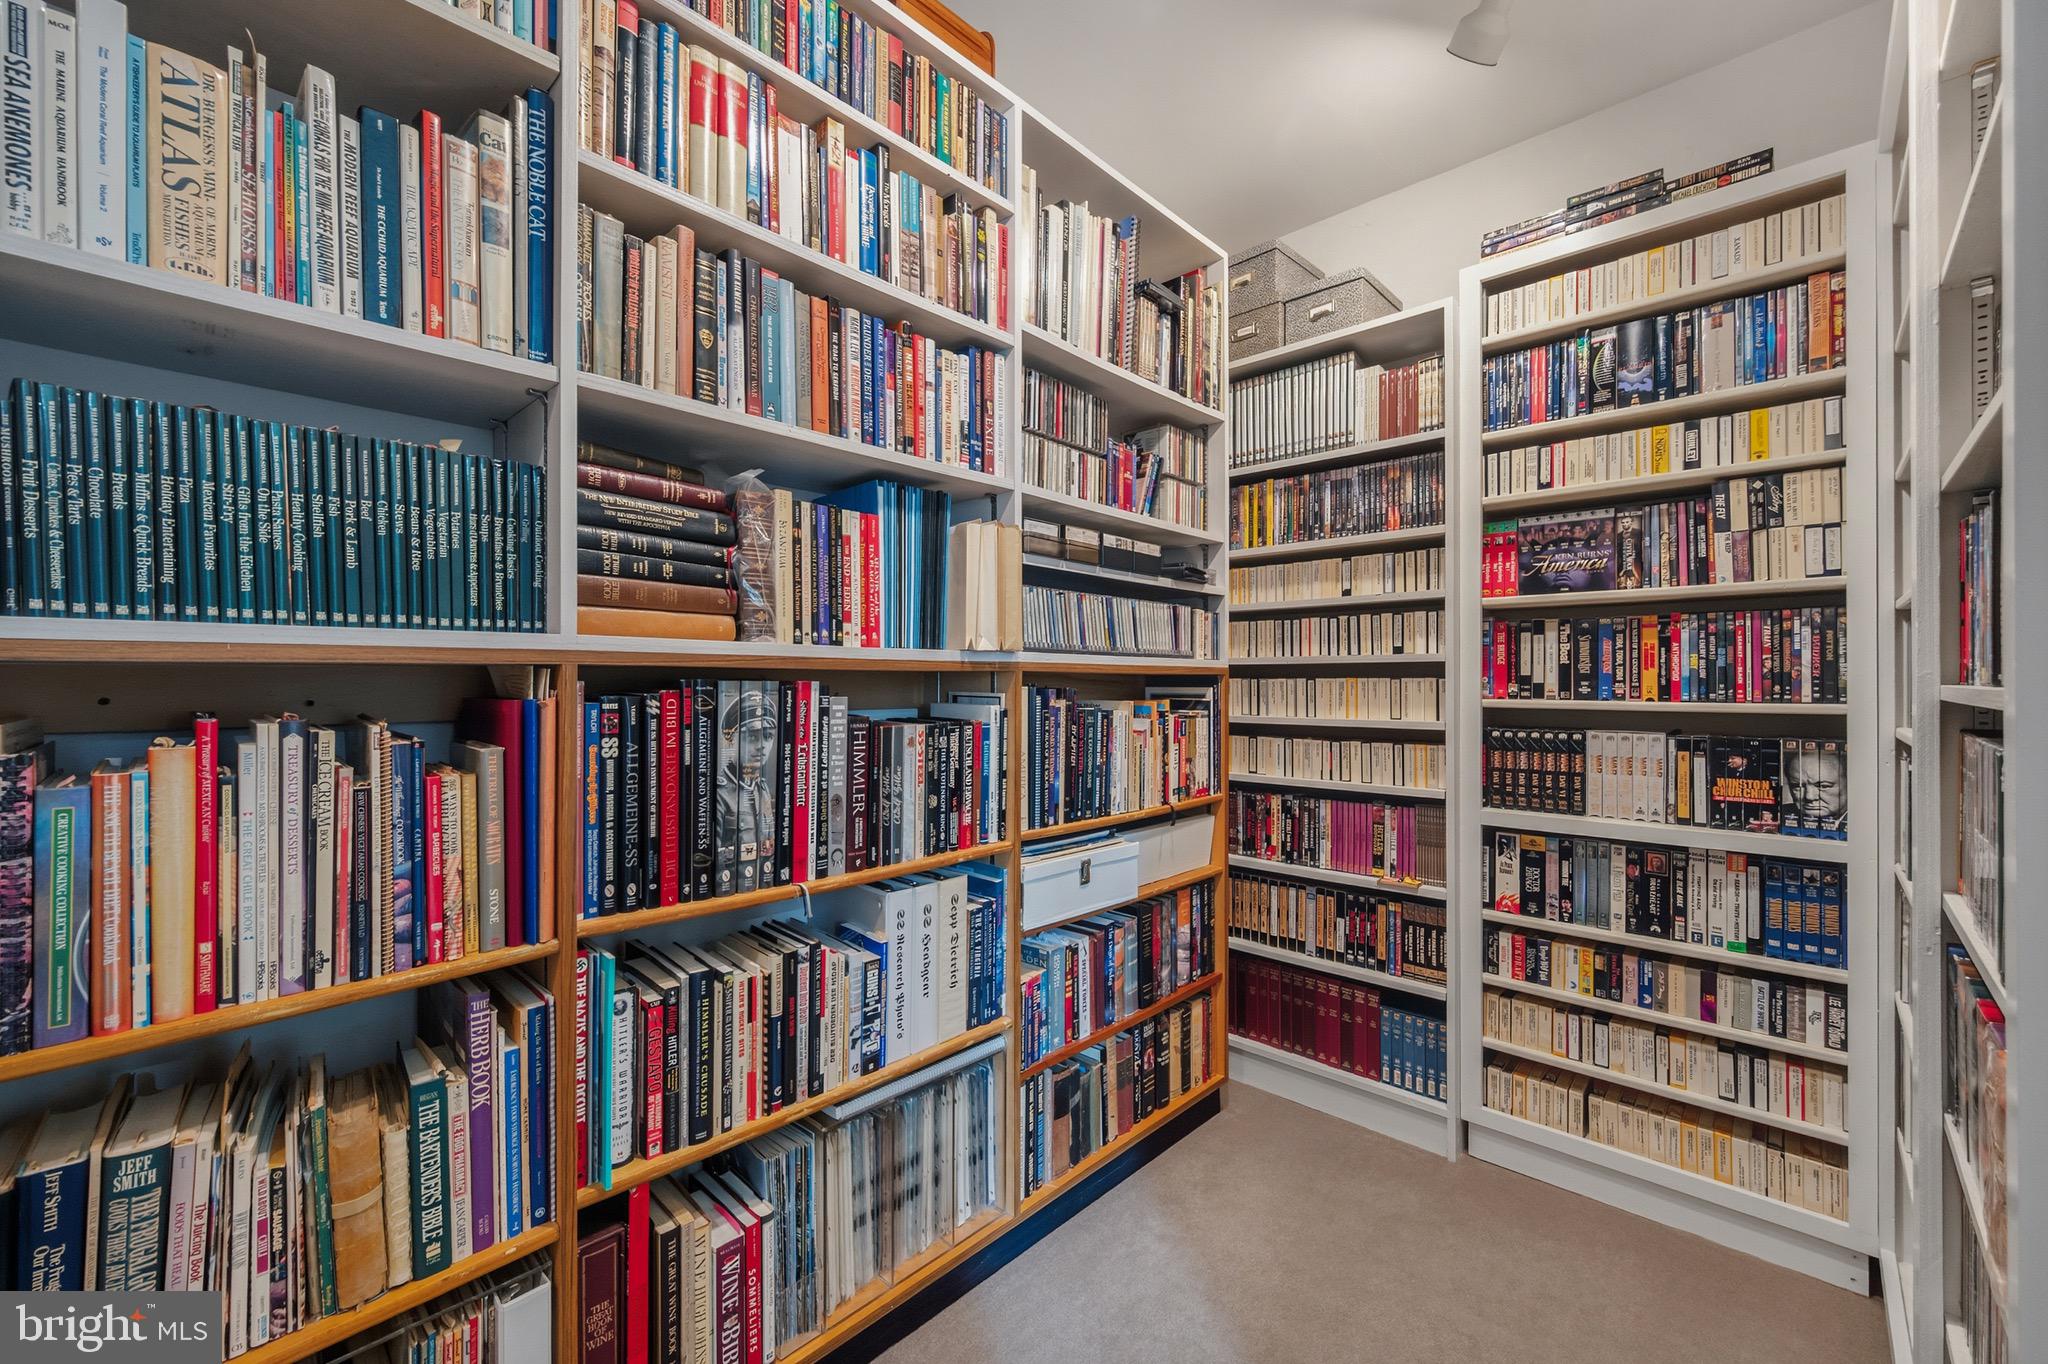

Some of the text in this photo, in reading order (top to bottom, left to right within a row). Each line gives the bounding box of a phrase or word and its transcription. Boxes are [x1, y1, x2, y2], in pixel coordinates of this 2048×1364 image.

[4, 55, 30, 88] SEA
[202, 73, 214, 92] DR.
[4, 89, 31, 191] ANEMONES
[56, 50, 66, 206] THE MARINE AQUARIUM HANDBOOK
[161, 58, 201, 198] ATLAS
[203, 99, 215, 165] BURGESS'S
[344, 142, 357, 190] MODERN
[528, 109, 546, 241] THE NOBLE CAT
[163, 194, 171, 246] MINI-EDITION
[175, 198, 189, 250] FISHES
[194, 203, 204, 256] AQUARIUM
[241, 169, 256, 255] SEAHORSES
[345, 194, 358, 217] REEF
[206, 206, 216, 258] OF MARINE
[346, 220, 358, 279] AQUARIUM
[378, 221, 386, 252] CICHLID
[378, 253, 387, 297] AQUARIUM
[629, 249, 640, 277] WORLDS
[628, 289, 640, 328] COLLISION
[864, 369, 872, 401] DECEIT
[22, 459, 40, 538] Fruit Desserts
[66, 464, 82, 486] Pies
[87, 467, 104, 518] Chocolate
[112, 473, 127, 510] Breads
[179, 477, 193, 503] Pizza
[67, 498, 84, 525] Tarts
[159, 475, 175, 583] Holiday Entertaining
[345, 500, 357, 524] Pork
[377, 500, 388, 535] Chicken
[346, 540, 358, 568] Lamb
[843, 556, 851, 576] END
[699, 716, 707, 774] ALLGEMEINE
[287, 745, 298, 805] TREASURY
[318, 740, 332, 851] THE ICE CREAM BOOK
[852, 730, 866, 815] HIMMLER
[242, 820, 253, 838] THE
[625, 742, 639, 867] ALLGEMEINE-SS
[698, 797, 707, 849] WAFFEN-SS
[242, 841, 253, 873] GREAT
[288, 819, 299, 875] DESSERTS
[54, 813, 68, 950] CREATIVE COOKING COLLECTION
[242, 876, 253, 903] CHILE
[489, 889, 499, 924] STONE
[242, 906, 253, 933] BOOK
[471, 1009, 492, 1111] HERB BOOK
[619, 1017, 628, 1120] HITLER'S WARRIOR
[649, 1027, 662, 1094] GESTAPO
[667, 1036, 677, 1066] HITLER
[700, 998, 709, 1117] HIMMLER'S CRUSADE
[112, 1168, 157, 1192] SMITH
[118, 1155, 152, 1173] JEFF
[418, 1100, 443, 1243] THE BARTENDER'S BIBLE
[128, 1187, 161, 1270] THE FRUGAL
[175, 1202, 186, 1232] FOODS
[190, 1202, 207, 1283] The Juicing Book
[174, 1234, 185, 1261] THAT
[591, 1300, 610, 1313] THE
[668, 1239, 677, 1355] THE GREAT WINE BOOK
[721, 1255, 740, 1313] WINE
[748, 1268, 757, 1353] SOMMELIERS
[587, 1329, 614, 1350] WINE
